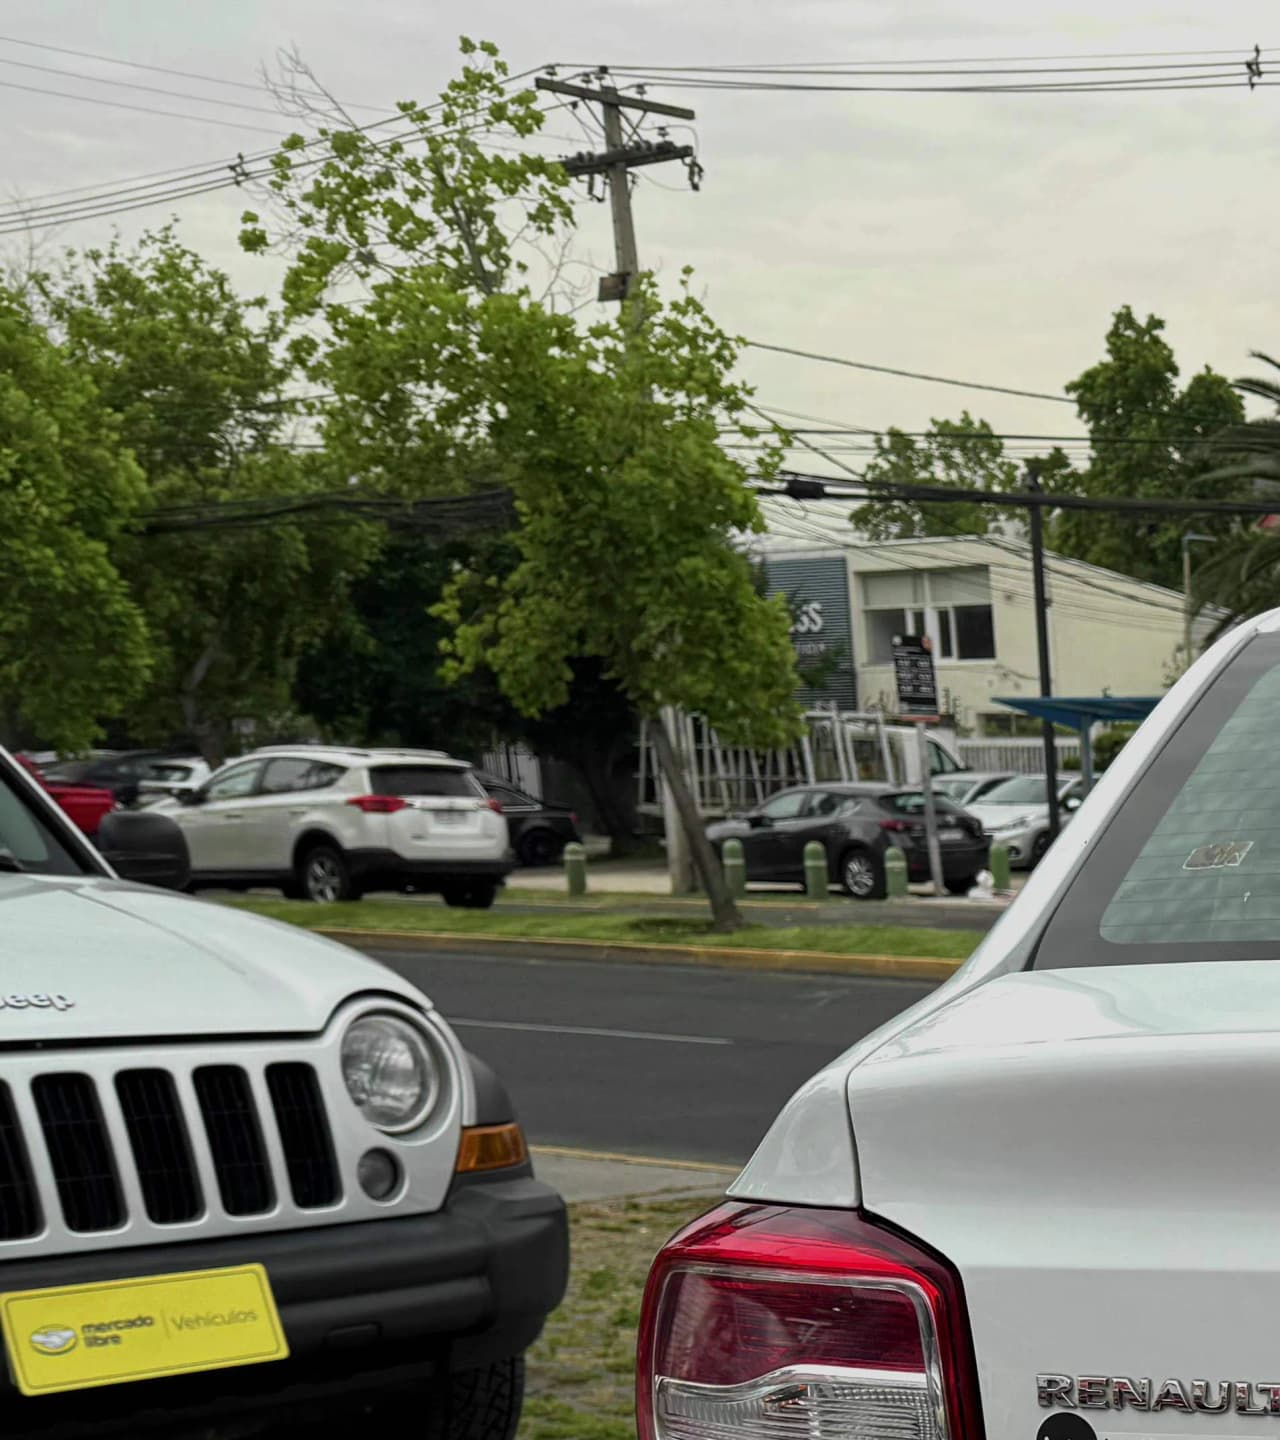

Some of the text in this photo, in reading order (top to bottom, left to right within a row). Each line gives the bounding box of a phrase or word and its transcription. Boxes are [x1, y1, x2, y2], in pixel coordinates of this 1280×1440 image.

[0, 991, 75, 1012] eep
[81, 1315, 155, 1334] mercado
[84, 1333, 121, 1349] libre
